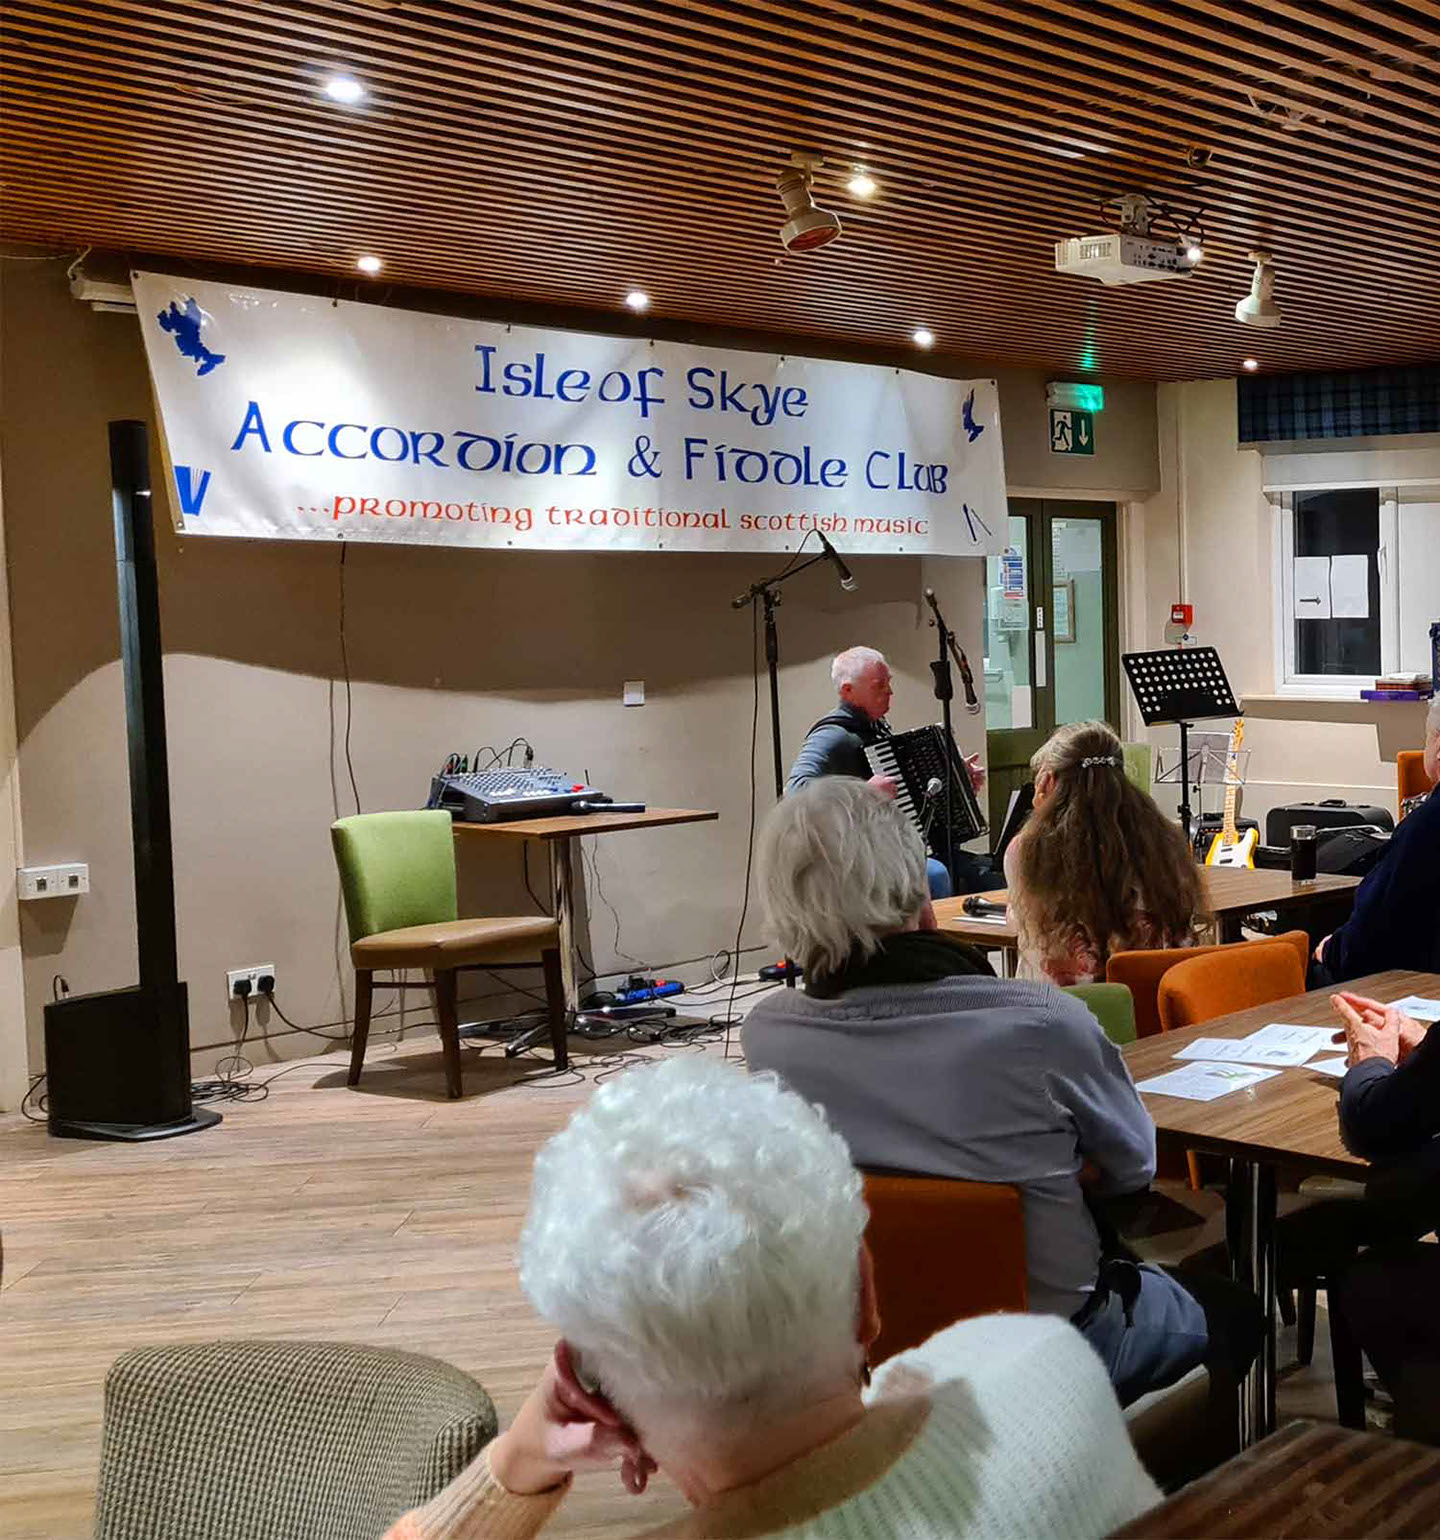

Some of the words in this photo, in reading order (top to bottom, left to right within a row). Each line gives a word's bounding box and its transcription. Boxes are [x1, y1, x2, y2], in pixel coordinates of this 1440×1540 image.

[474, 344, 592, 403] Isle
[599, 367, 665, 419] of
[687, 366, 810, 426] Skye
[627, 434, 663, 479] &
[546, 506, 731, 531] traditional
[740, 513, 849, 534] scottish
[854, 517, 930, 536] music
